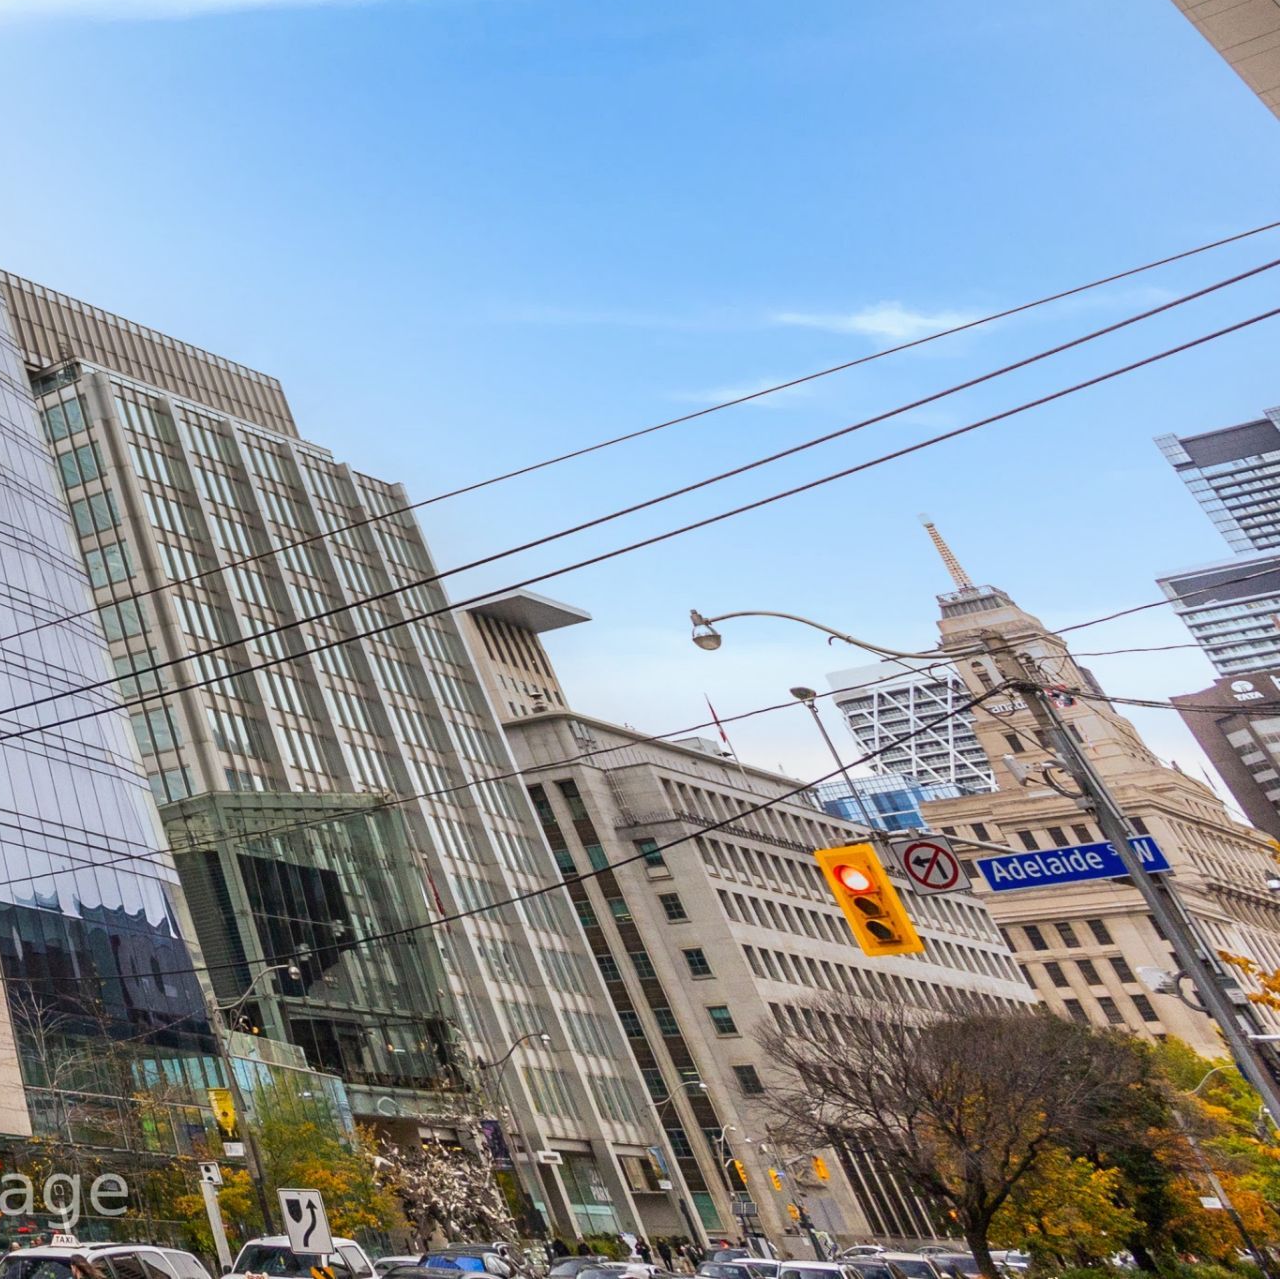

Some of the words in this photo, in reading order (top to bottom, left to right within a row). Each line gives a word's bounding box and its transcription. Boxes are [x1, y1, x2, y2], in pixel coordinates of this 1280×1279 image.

[1233, 691, 1265, 702] TATA
[991, 849, 1105, 883] Adelaide
[55, 1234, 76, 1245] TAXI
